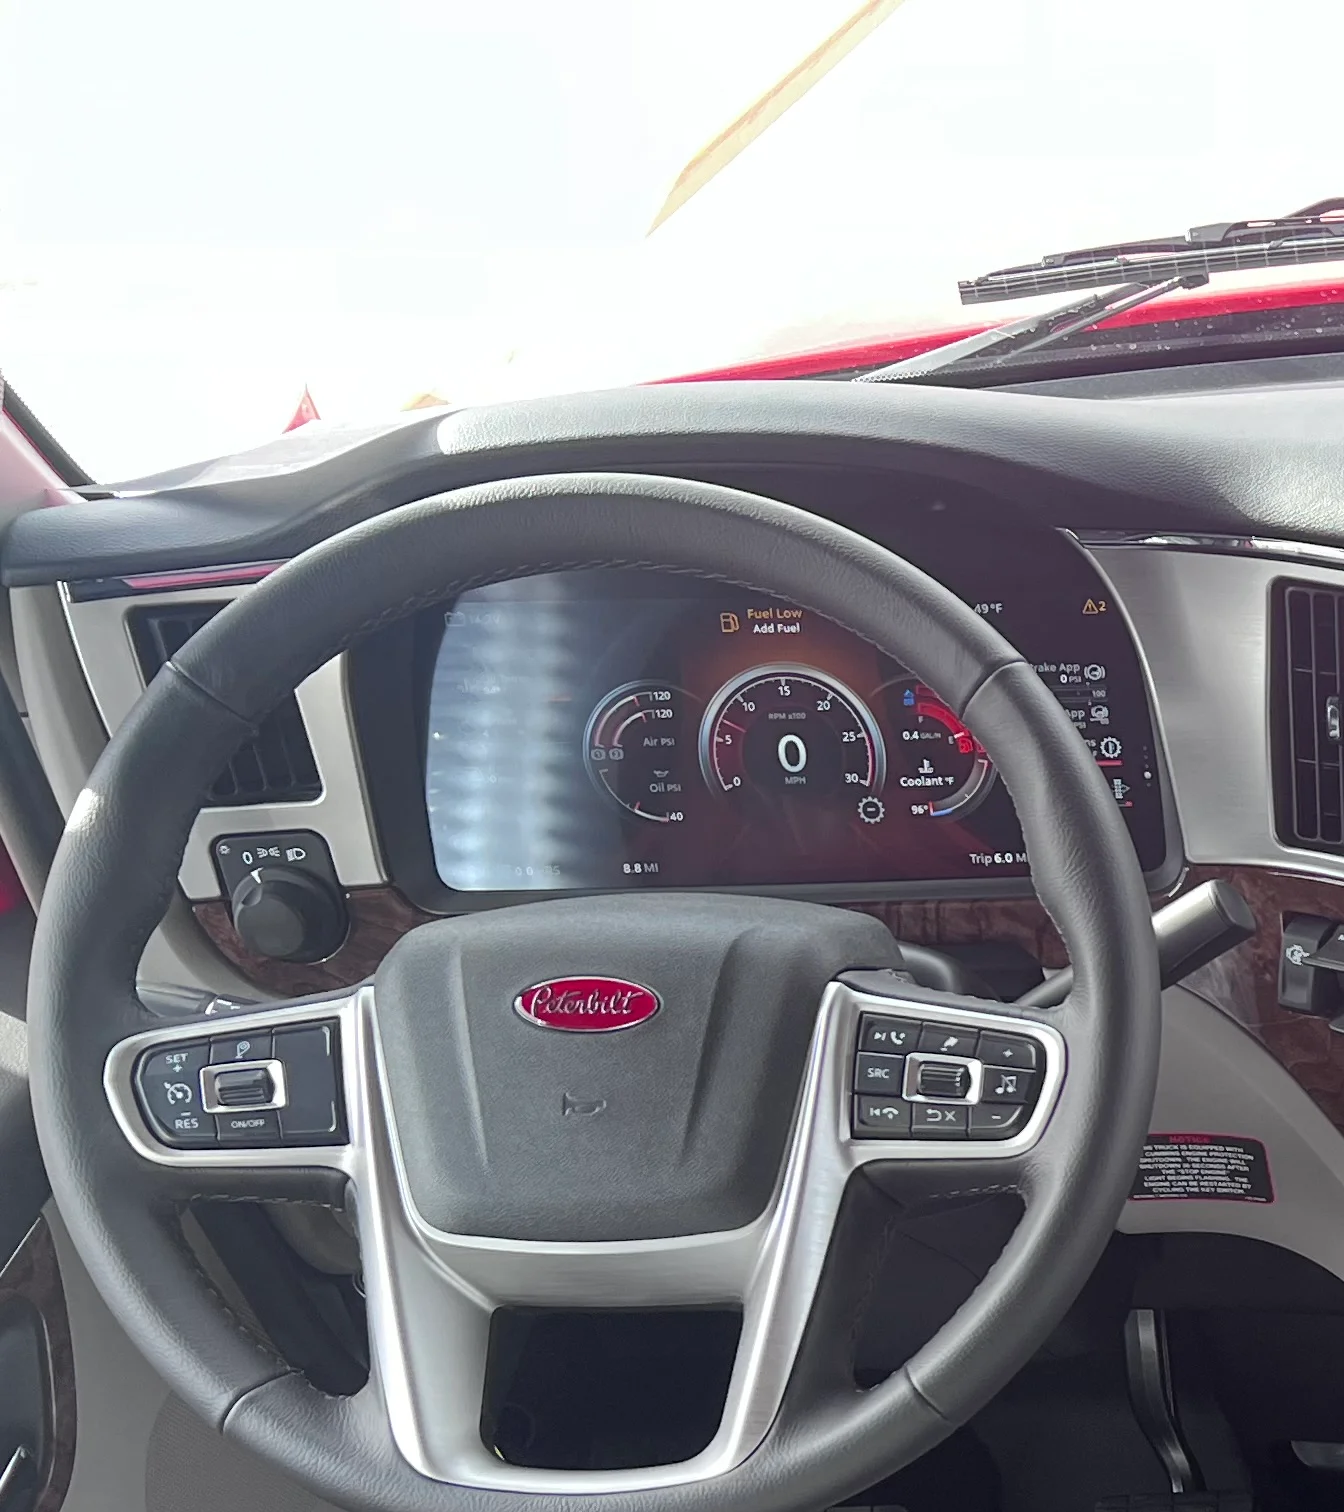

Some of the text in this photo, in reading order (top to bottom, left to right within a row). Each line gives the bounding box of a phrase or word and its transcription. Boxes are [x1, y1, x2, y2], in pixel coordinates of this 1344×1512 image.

[1098, 601, 1107, 611] 2
[747, 608, 803, 620] Fuel Low
[753, 622, 800, 634] Add Fuel
[1058, 663, 1081, 674] App
[1059, 674, 1082, 683] 0 PSI
[653, 690, 671, 701] 120
[778, 686, 791, 696] 15
[743, 702, 756, 712] 10
[817, 701, 831, 711] 20
[656, 709, 673, 719] 120
[768, 712, 786, 720] RPM
[725, 735, 733, 745] 5
[842, 732, 856, 743] 25
[902, 731, 920, 741] 0.4
[643, 737, 675, 747] Air PSI
[778, 734, 807, 773] 0
[733, 777, 741, 787] 0
[785, 776, 806, 785] MPH
[845, 773, 859, 784] 30
[900, 776, 943, 787] Coolant
[649, 783, 681, 793] Oil PSI
[670, 812, 684, 821] 40
[969, 853, 1014, 866] Trip 6.0
[623, 863, 659, 873] 8.8 MI
[530, 986, 644, 1017] Peterbilt
[165, 1053, 188, 1064] SET
[867, 1067, 890, 1079] SRC
[175, 1118, 199, 1129] RES
[230, 1118, 266, 1129] ON/OFF
